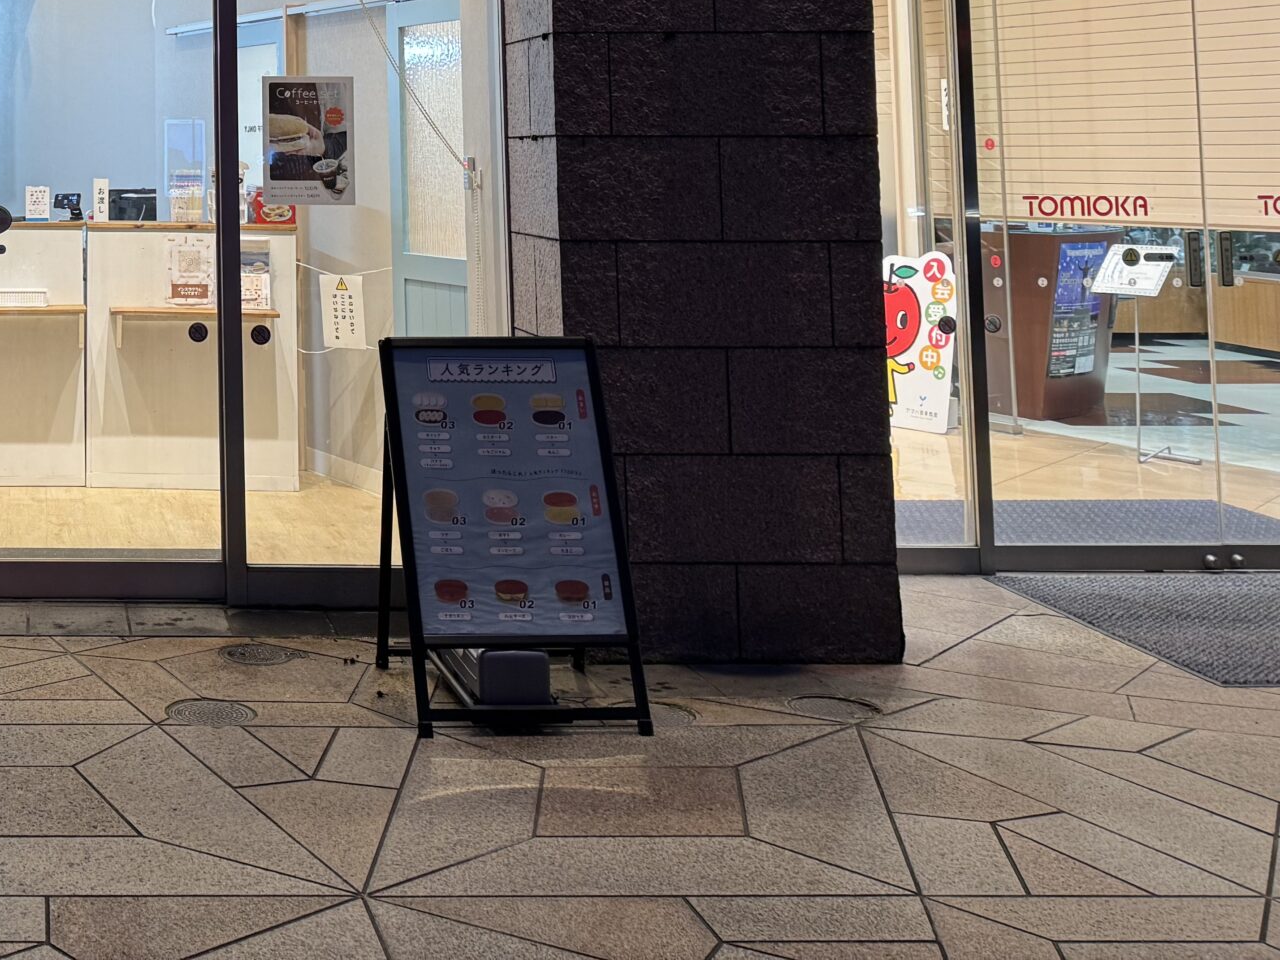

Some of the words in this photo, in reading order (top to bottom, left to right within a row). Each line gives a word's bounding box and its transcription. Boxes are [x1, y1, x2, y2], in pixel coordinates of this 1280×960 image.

[276, 87, 316, 99] Coffee
[97, 187, 106, 214] お渡し
[1022, 195, 1149, 217] TOMIOKA
[440, 362, 545, 378] 人気ランキング
[440, 420, 456, 430] 03
[498, 420, 514, 431] 02
[558, 420, 573, 431] 01
[451, 516, 467, 526] 03
[511, 516, 526, 527] 02
[571, 516, 586, 527] 01
[459, 599, 475, 609] 03
[519, 599, 535, 609] 02
[582, 600, 597, 610] 01
